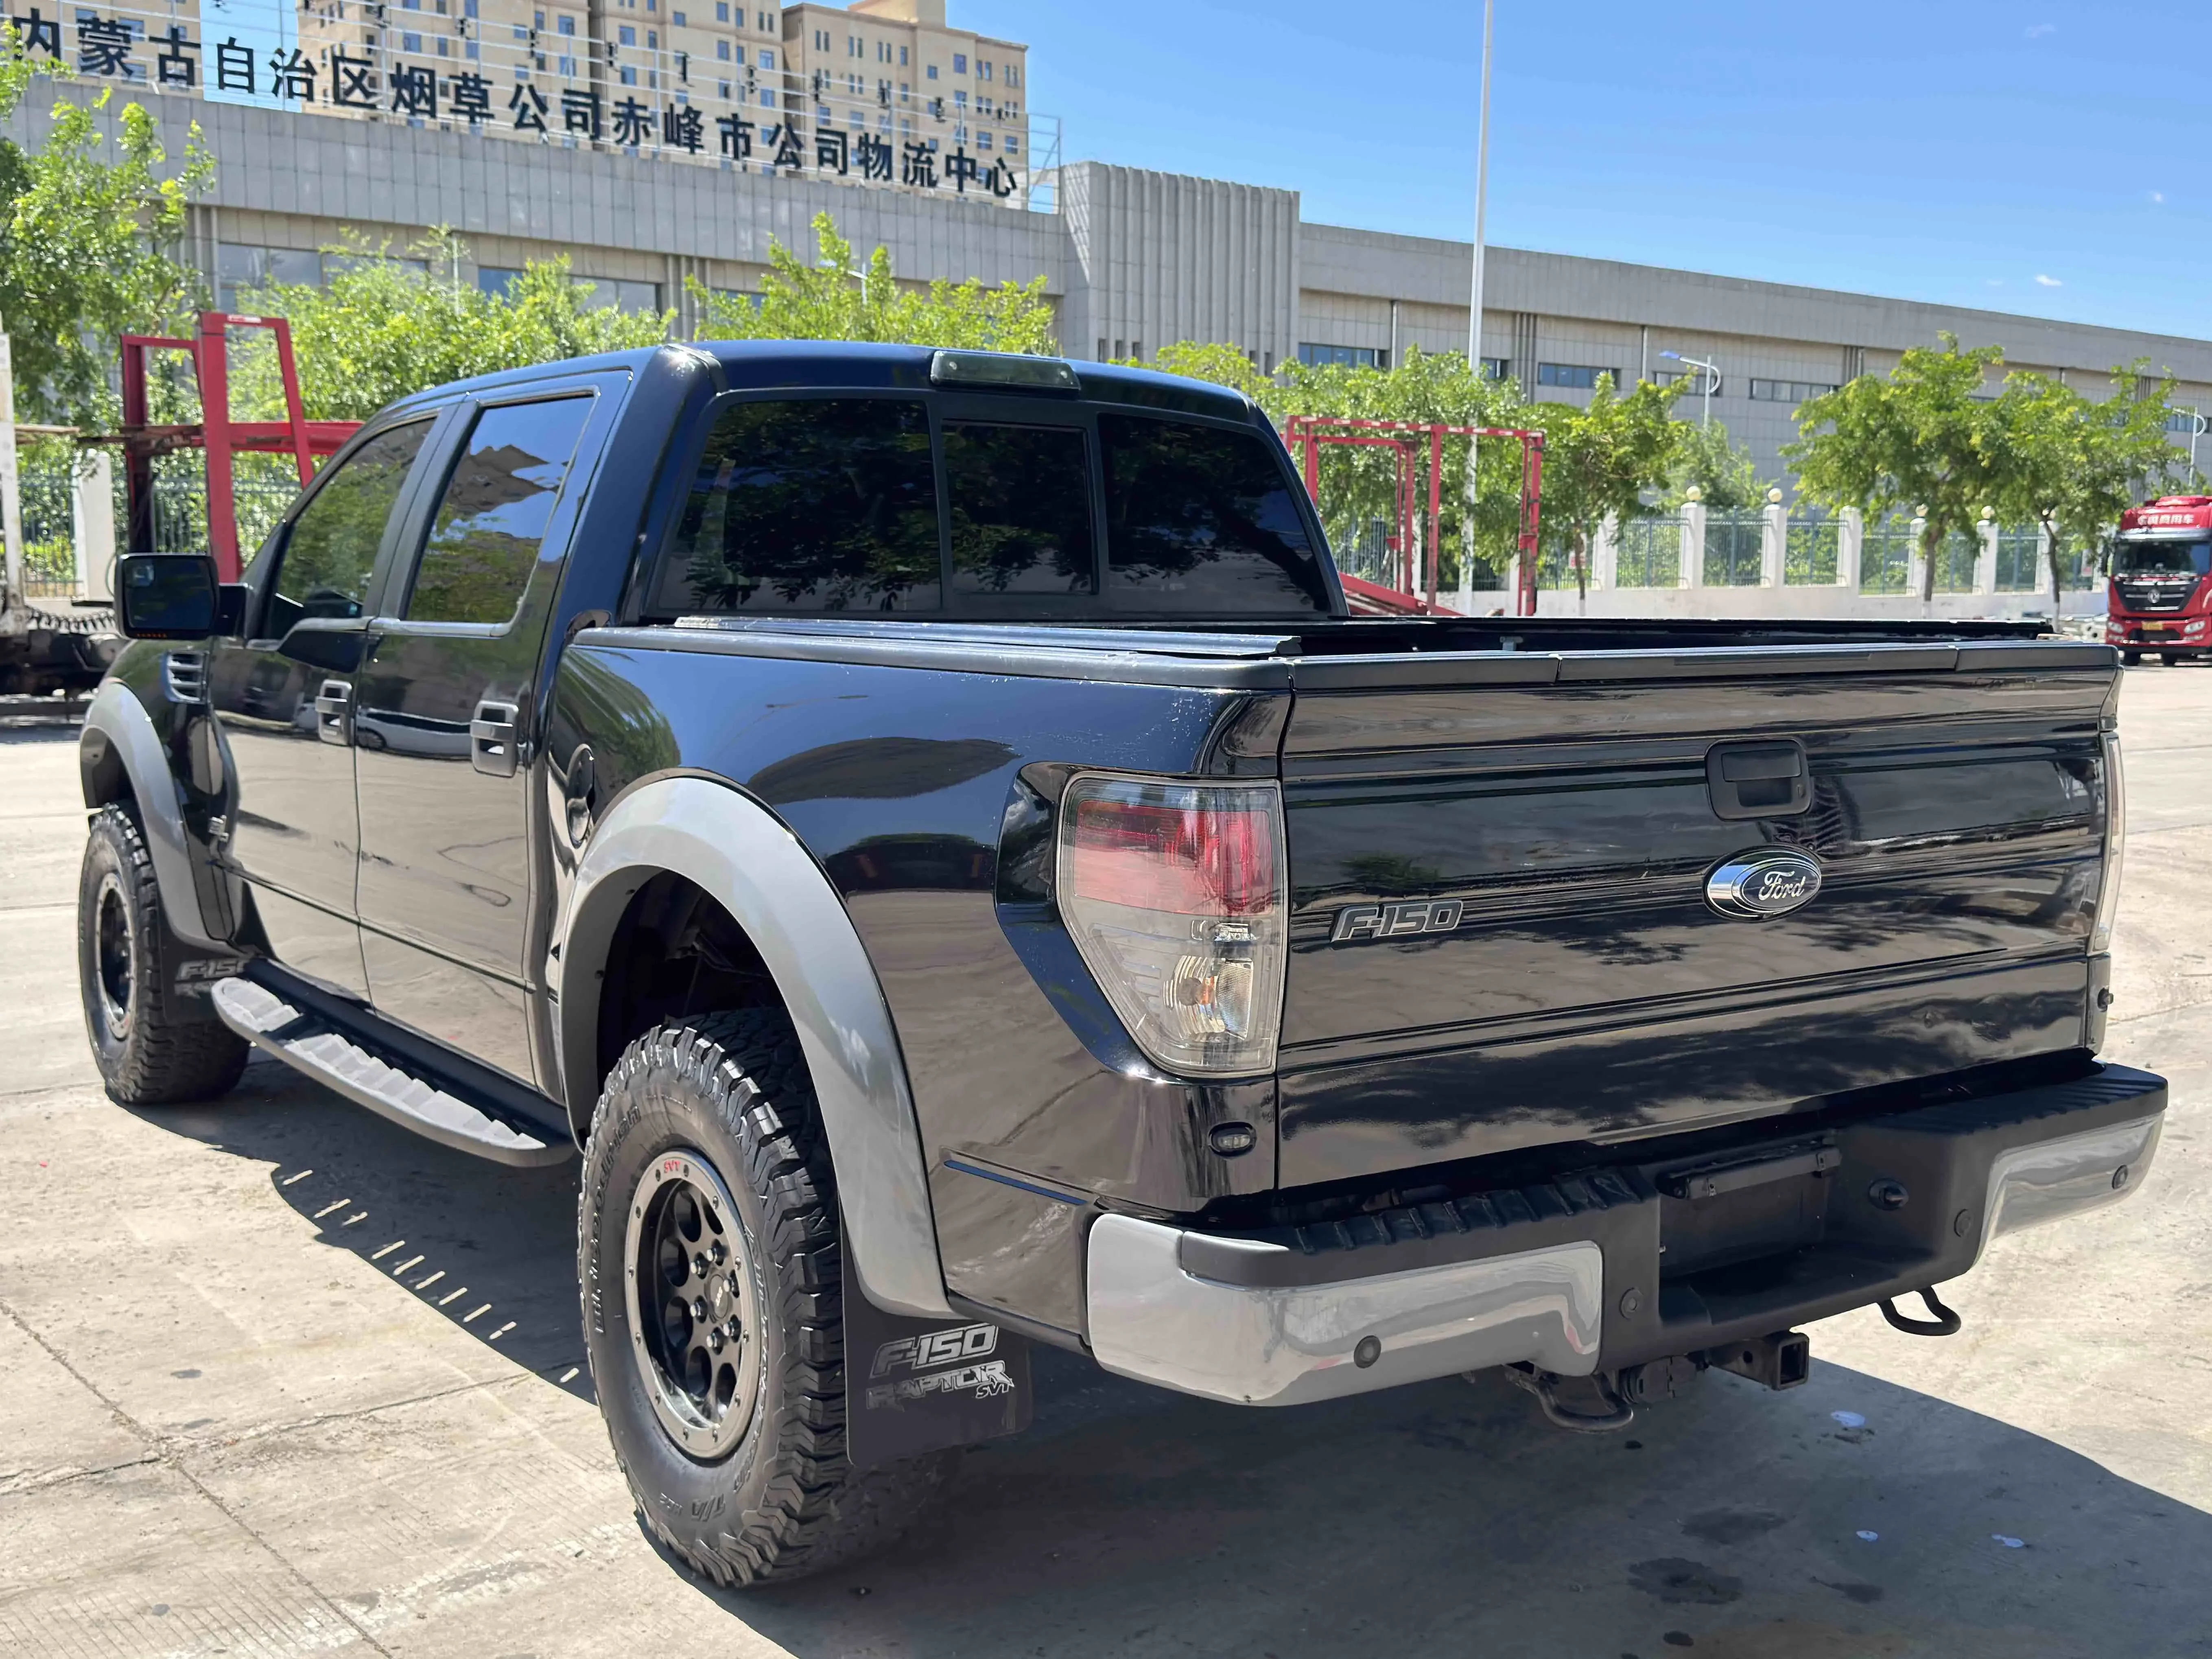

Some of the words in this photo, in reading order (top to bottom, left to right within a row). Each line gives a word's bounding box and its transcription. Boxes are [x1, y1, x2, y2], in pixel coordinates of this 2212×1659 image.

[13, 7, 1016, 198] 内蒙古自治区烟草公司赤峰市公司物流中心
[1758, 871, 1806, 901] Ford
[1331, 900, 1464, 942] F-150
[664, 1160, 680, 1173] SVT
[869, 1322, 998, 1379] F-150
[866, 1360, 1015, 1413] RAPTOR
[975, 1382, 1010, 1399] SVT
